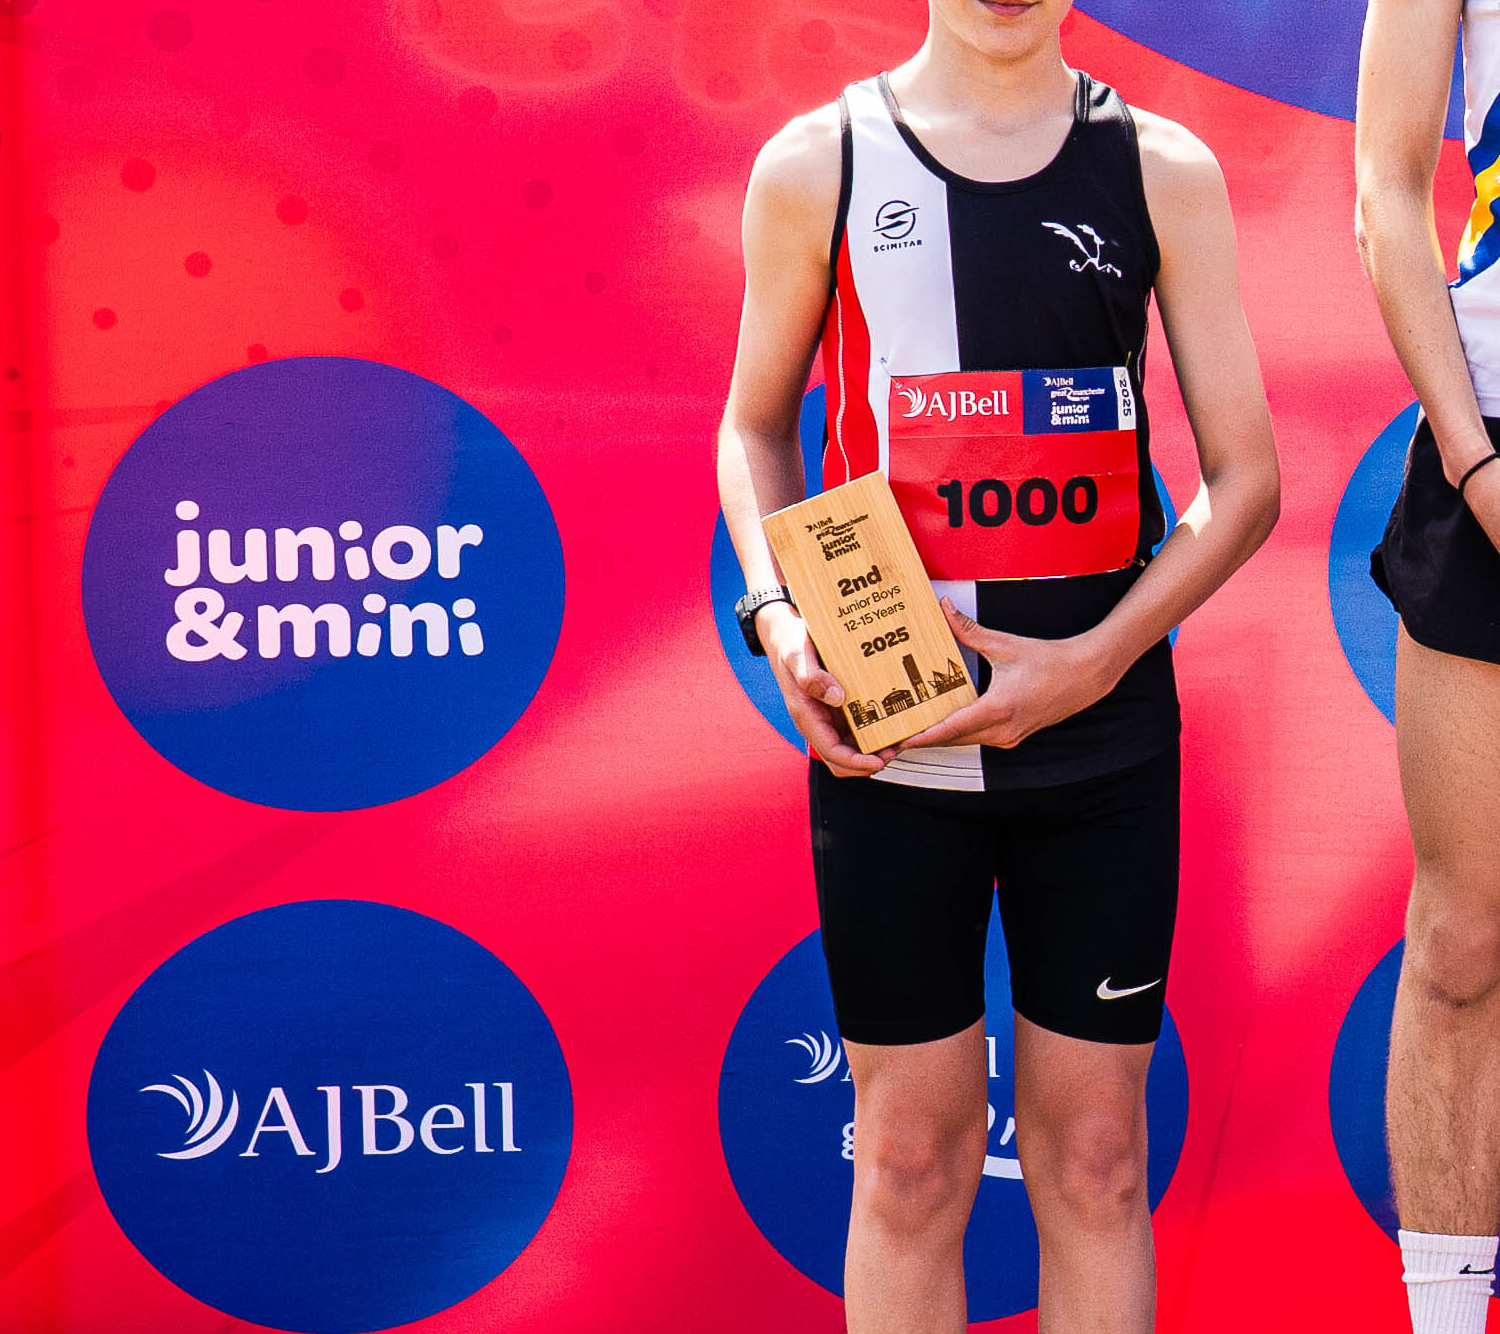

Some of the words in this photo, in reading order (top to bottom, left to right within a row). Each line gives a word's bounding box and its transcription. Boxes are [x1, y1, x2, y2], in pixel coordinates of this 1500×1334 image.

[873, 239, 923, 253] SCIMITAR
[925, 390, 1009, 422] AJBell
[1050, 402, 1090, 416] junior
[1118, 378, 1132, 417] 2025
[937, 476, 1099, 528] 1000
[165, 501, 483, 587] junior
[821, 532, 856, 552] junior
[837, 565, 883, 597] 2nd
[837, 596, 871, 618] Junior
[871, 585, 902, 603] Boys
[843, 612, 874, 633] 12-15
[872, 601, 906, 620] Years
[860, 626, 910, 658] 2025
[239, 1081, 523, 1175] AJBell
